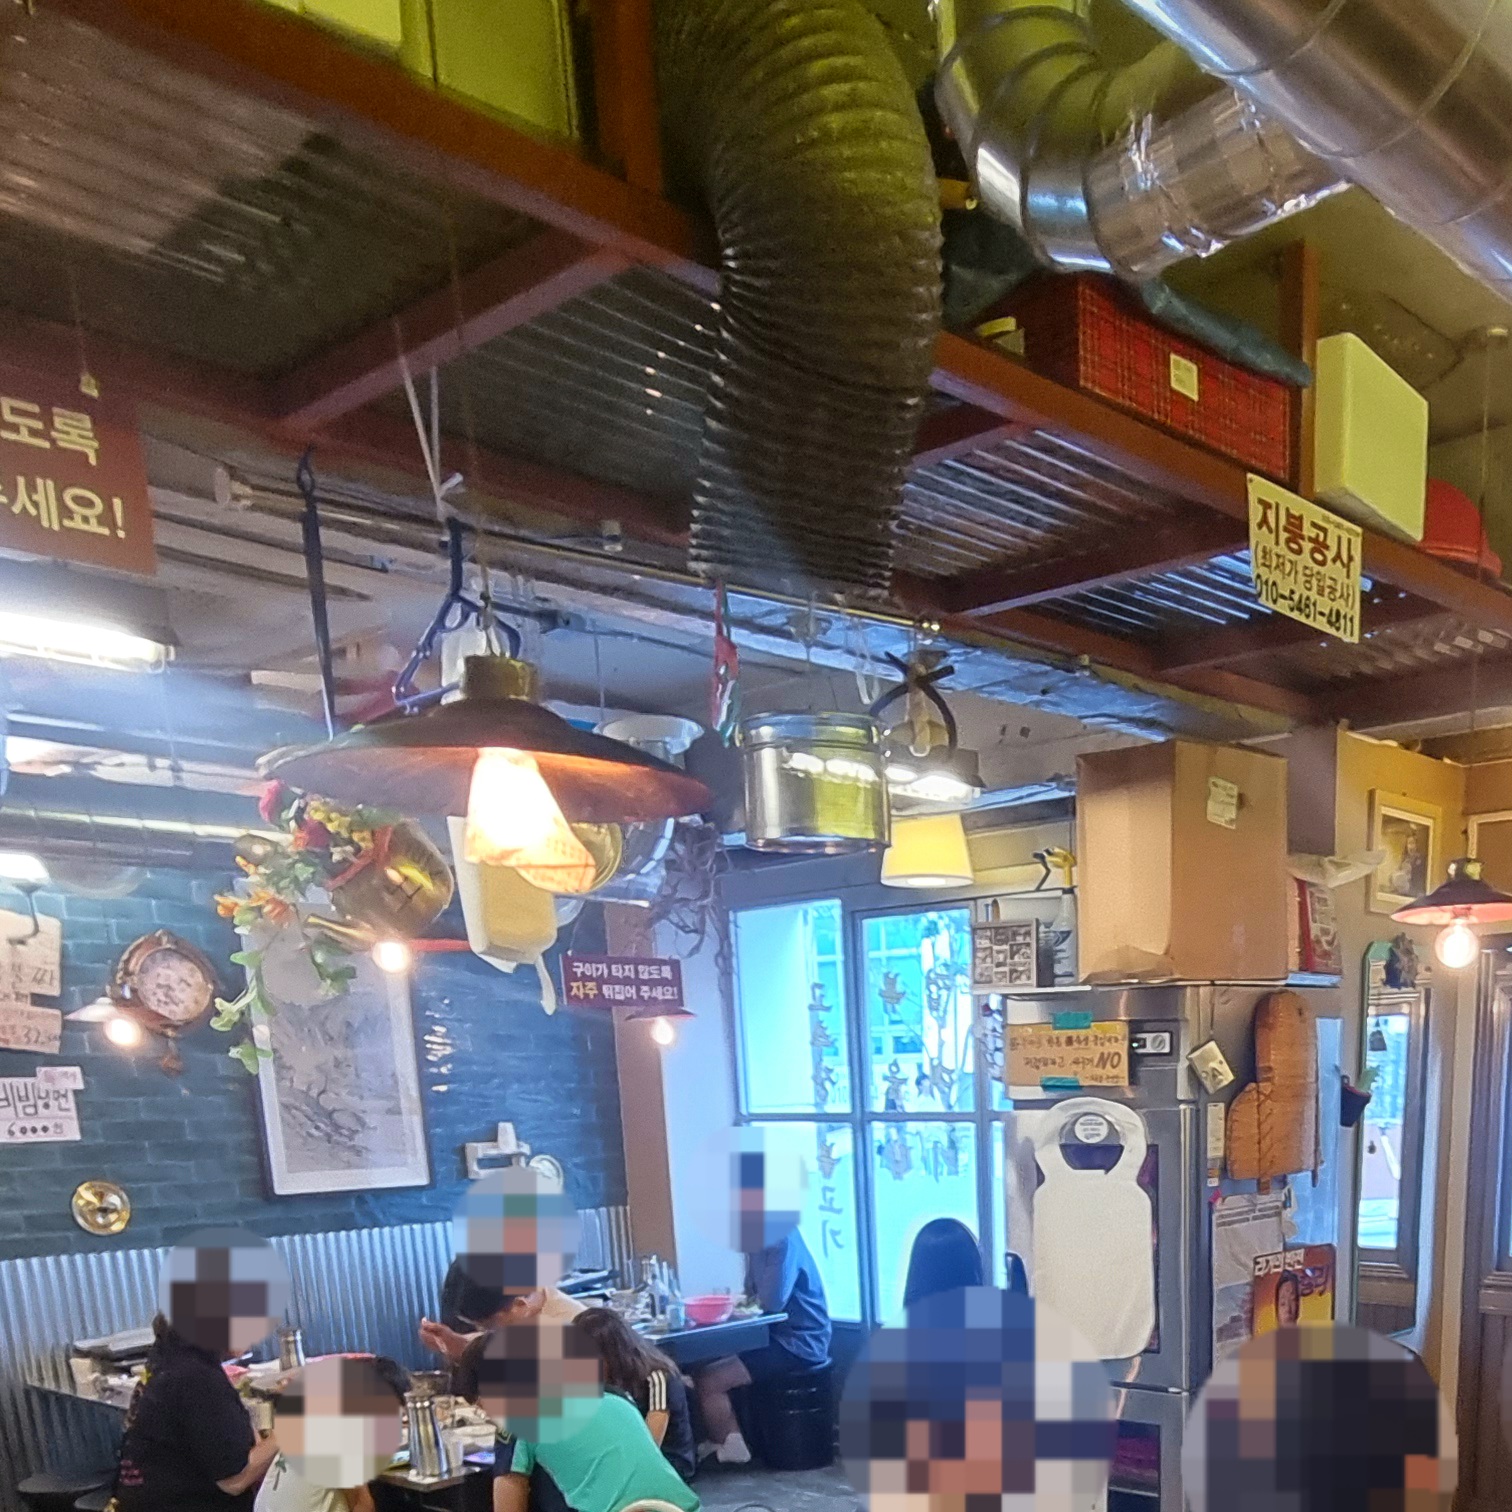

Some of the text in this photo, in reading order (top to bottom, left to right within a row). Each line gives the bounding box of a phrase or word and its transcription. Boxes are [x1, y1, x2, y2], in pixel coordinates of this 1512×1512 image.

[0, 475, 126, 539] 세요!
[1256, 497, 1355, 580] 지붕공사
[572, 961, 609, 979] 구이가
[610, 963, 635, 979] 타지
[570, 980, 679, 1000] 자주 뒤집어 주세요!
[1095, 1051, 1122, 1070] NO
